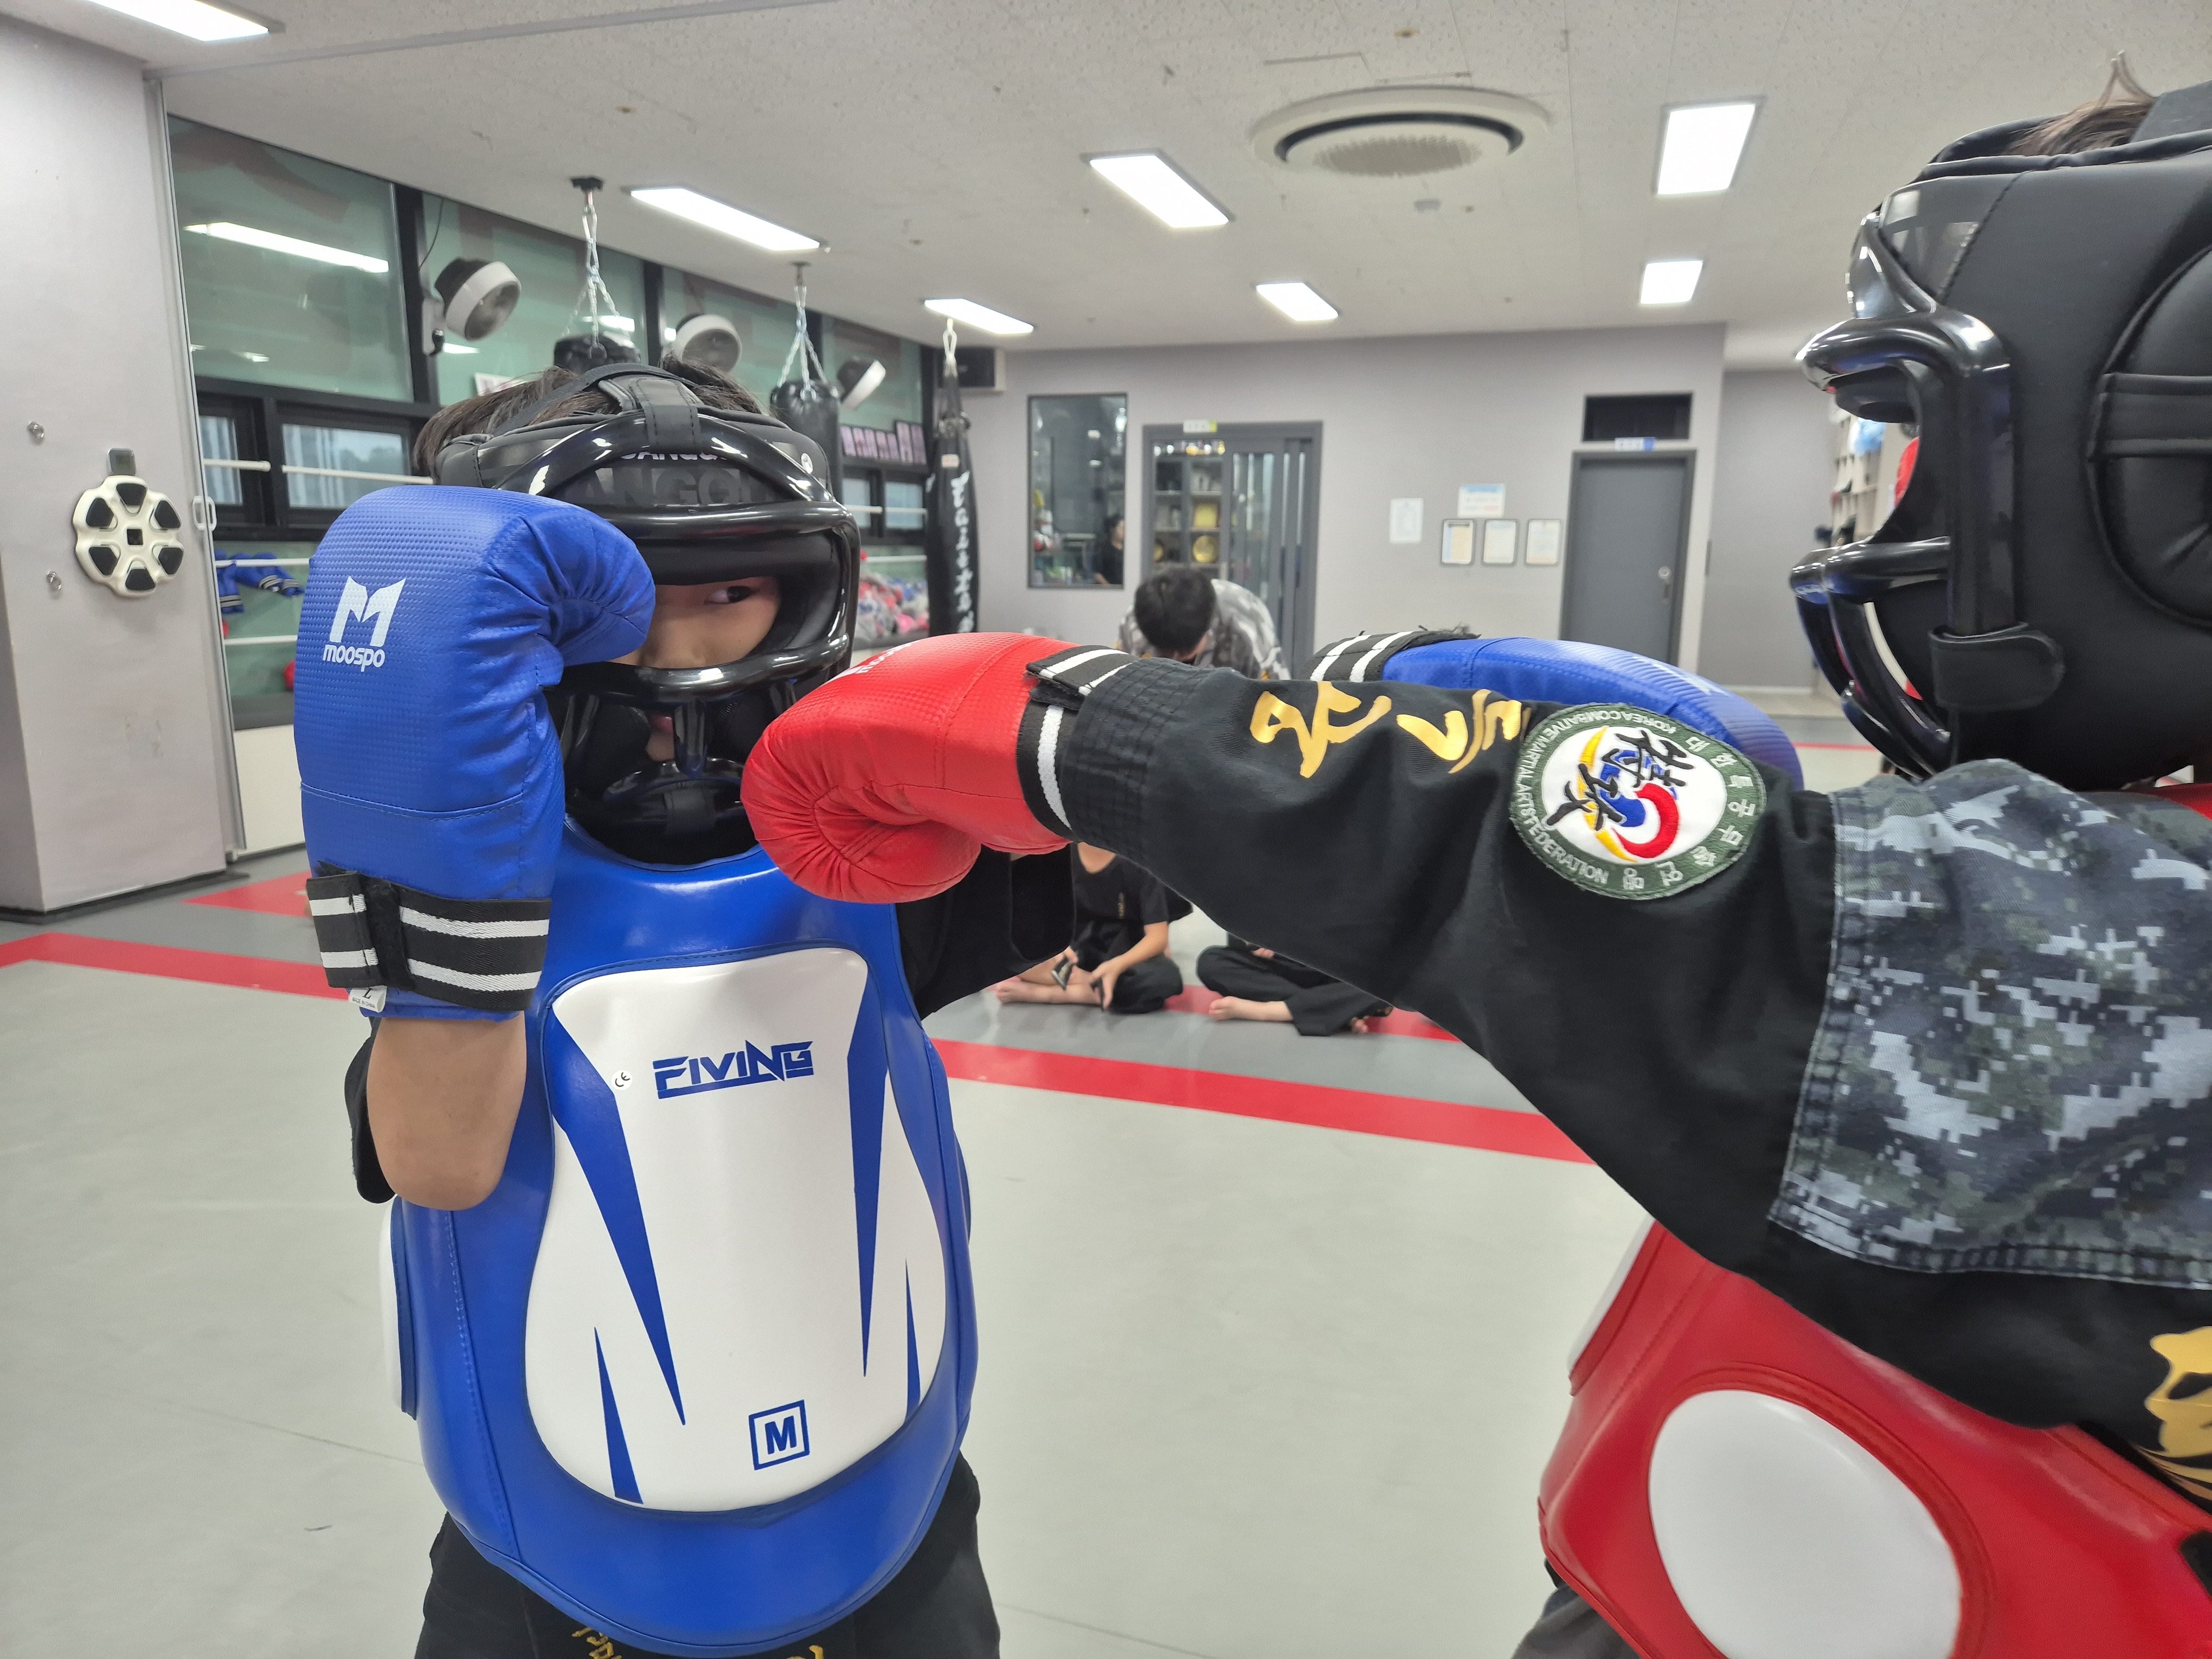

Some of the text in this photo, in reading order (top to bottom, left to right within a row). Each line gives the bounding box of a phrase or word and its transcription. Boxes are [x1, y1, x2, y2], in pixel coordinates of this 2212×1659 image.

[322, 645, 385, 672] moospo
[1517, 710, 1677, 885] KOREA COMBATIVE MARTIAL ARTS FEDERATION
[652, 1039, 815, 1099] FIVING
[764, 1415, 797, 1455] M
